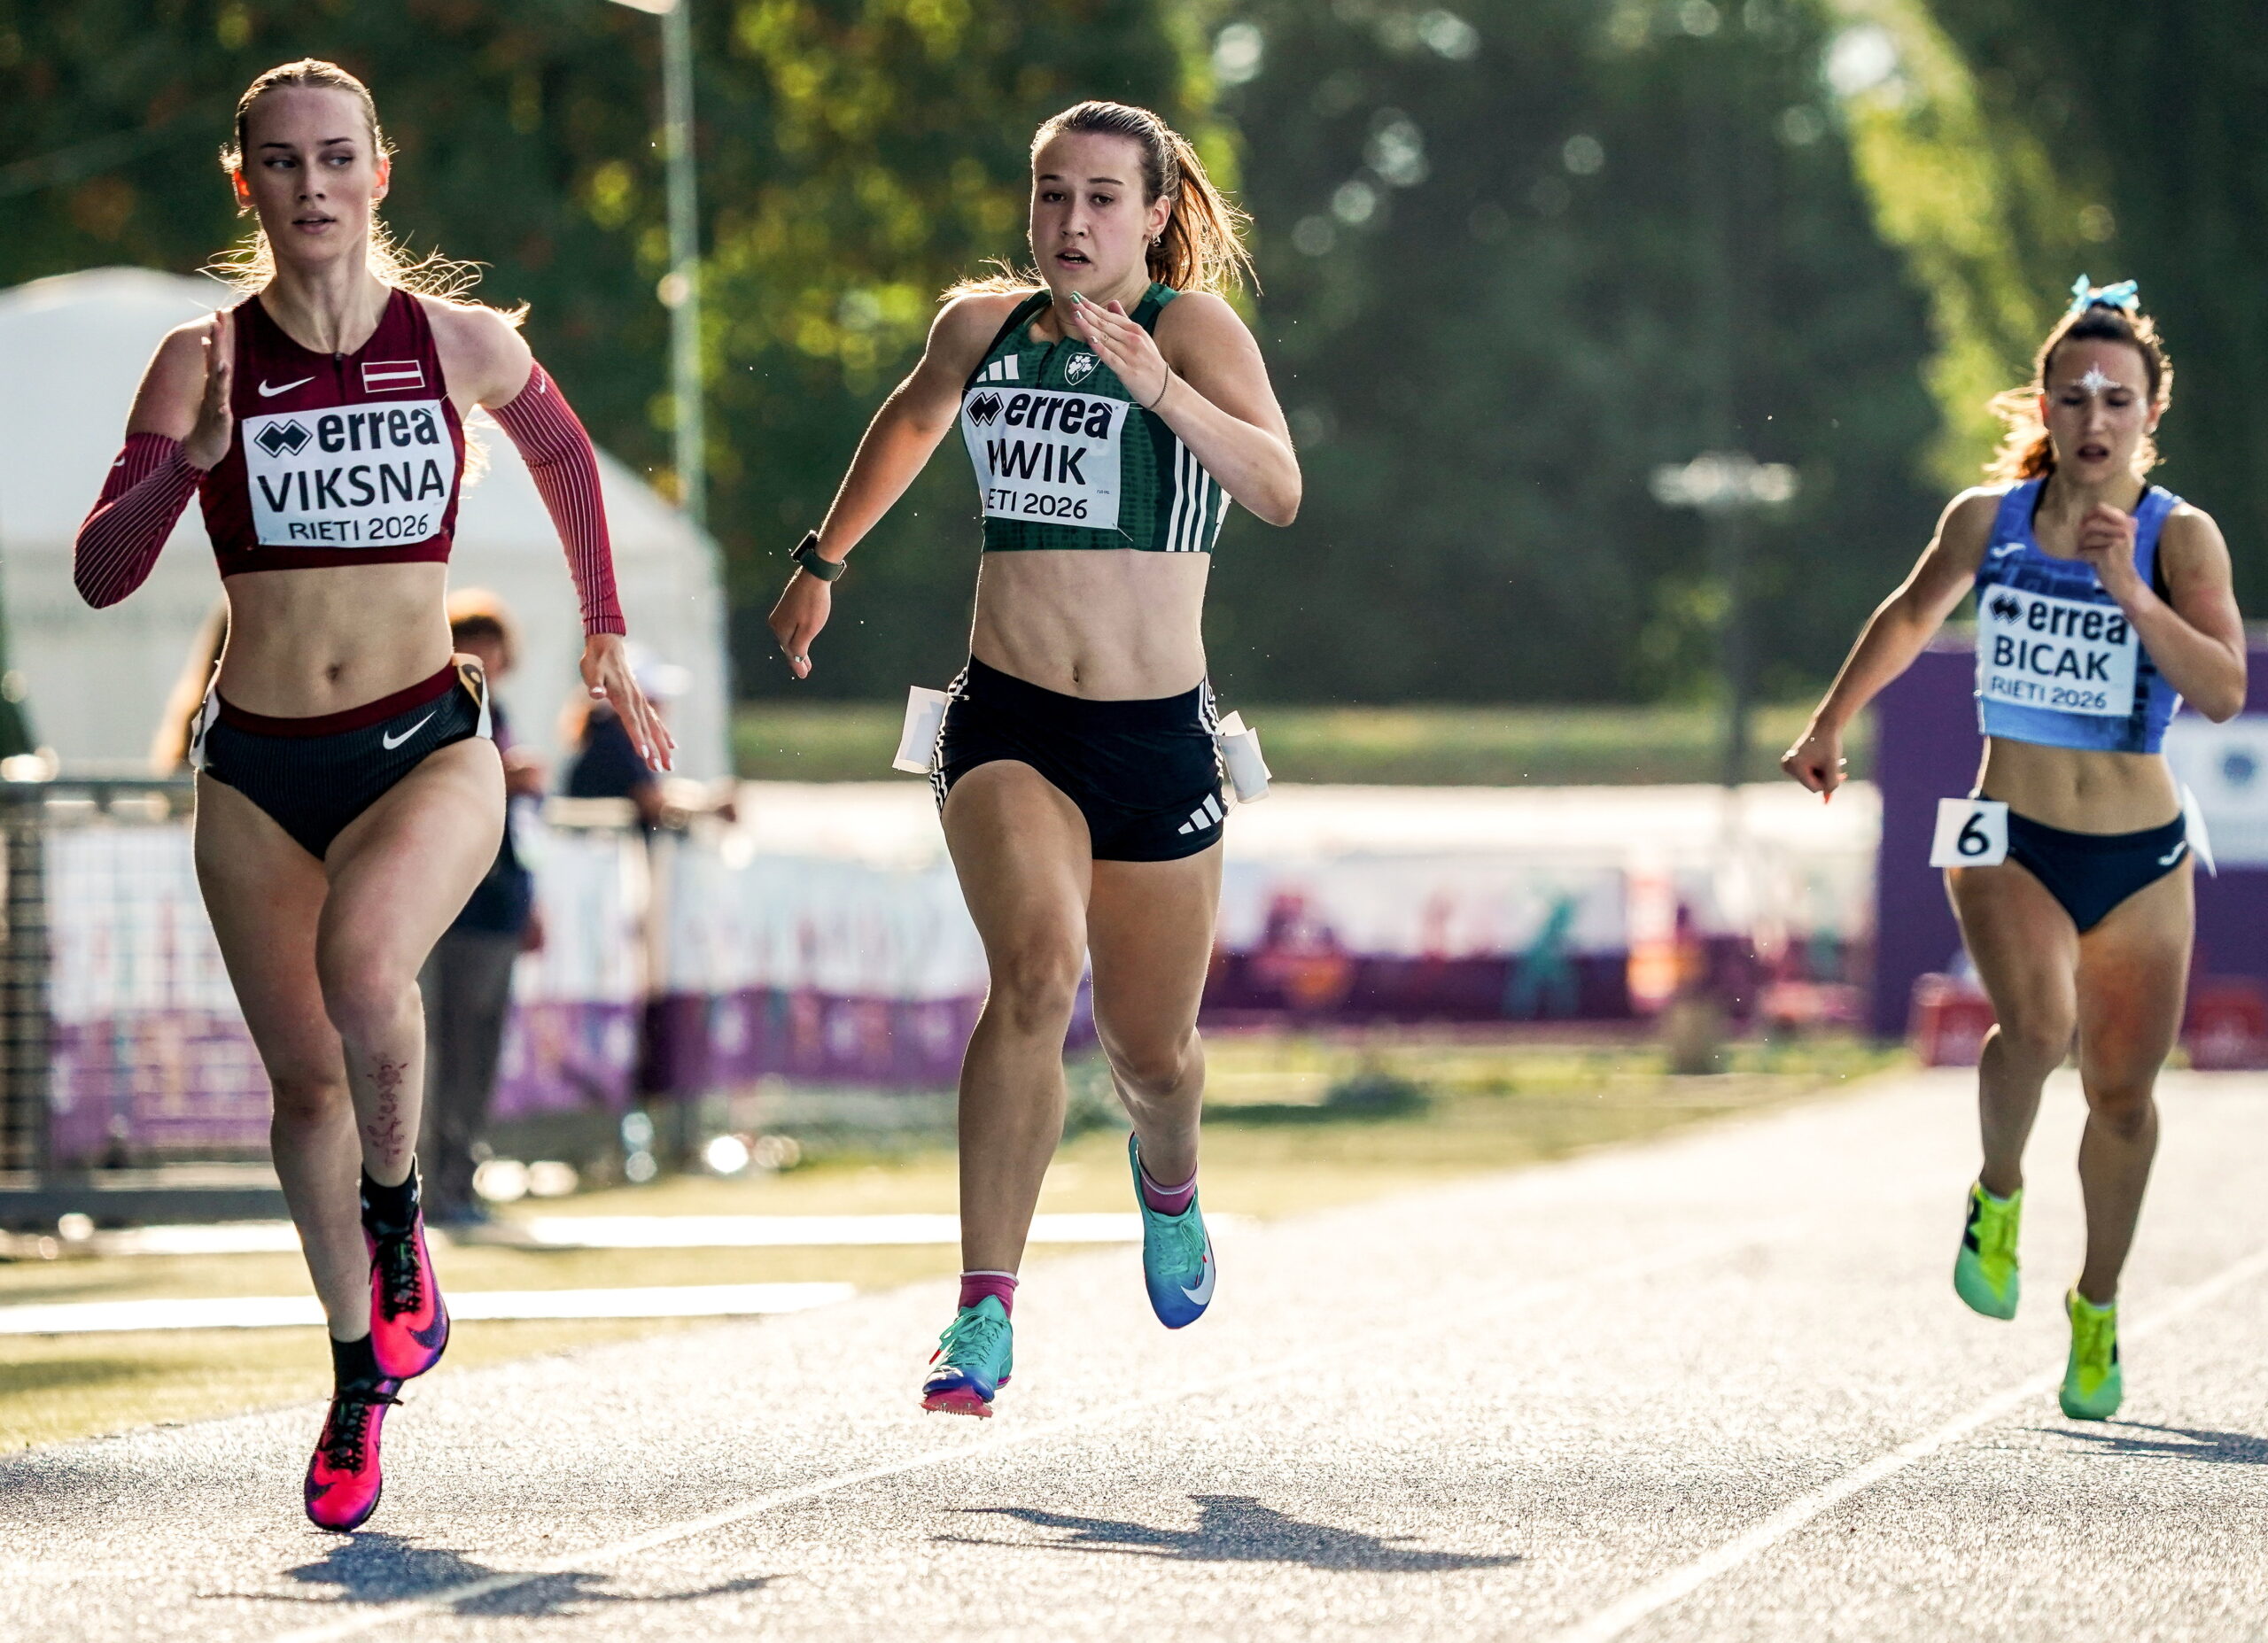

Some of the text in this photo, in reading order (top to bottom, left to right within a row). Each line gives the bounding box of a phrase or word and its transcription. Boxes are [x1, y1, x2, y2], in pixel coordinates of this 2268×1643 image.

[257, 459, 445, 512] VIKSNA
[985, 488, 1088, 519] ETI 2026
[289, 513, 430, 541] RIETI 2026
[1993, 634, 2111, 681] BICAK
[1992, 675, 2107, 709] RIETI 2026
[1957, 812, 1990, 856] 6
